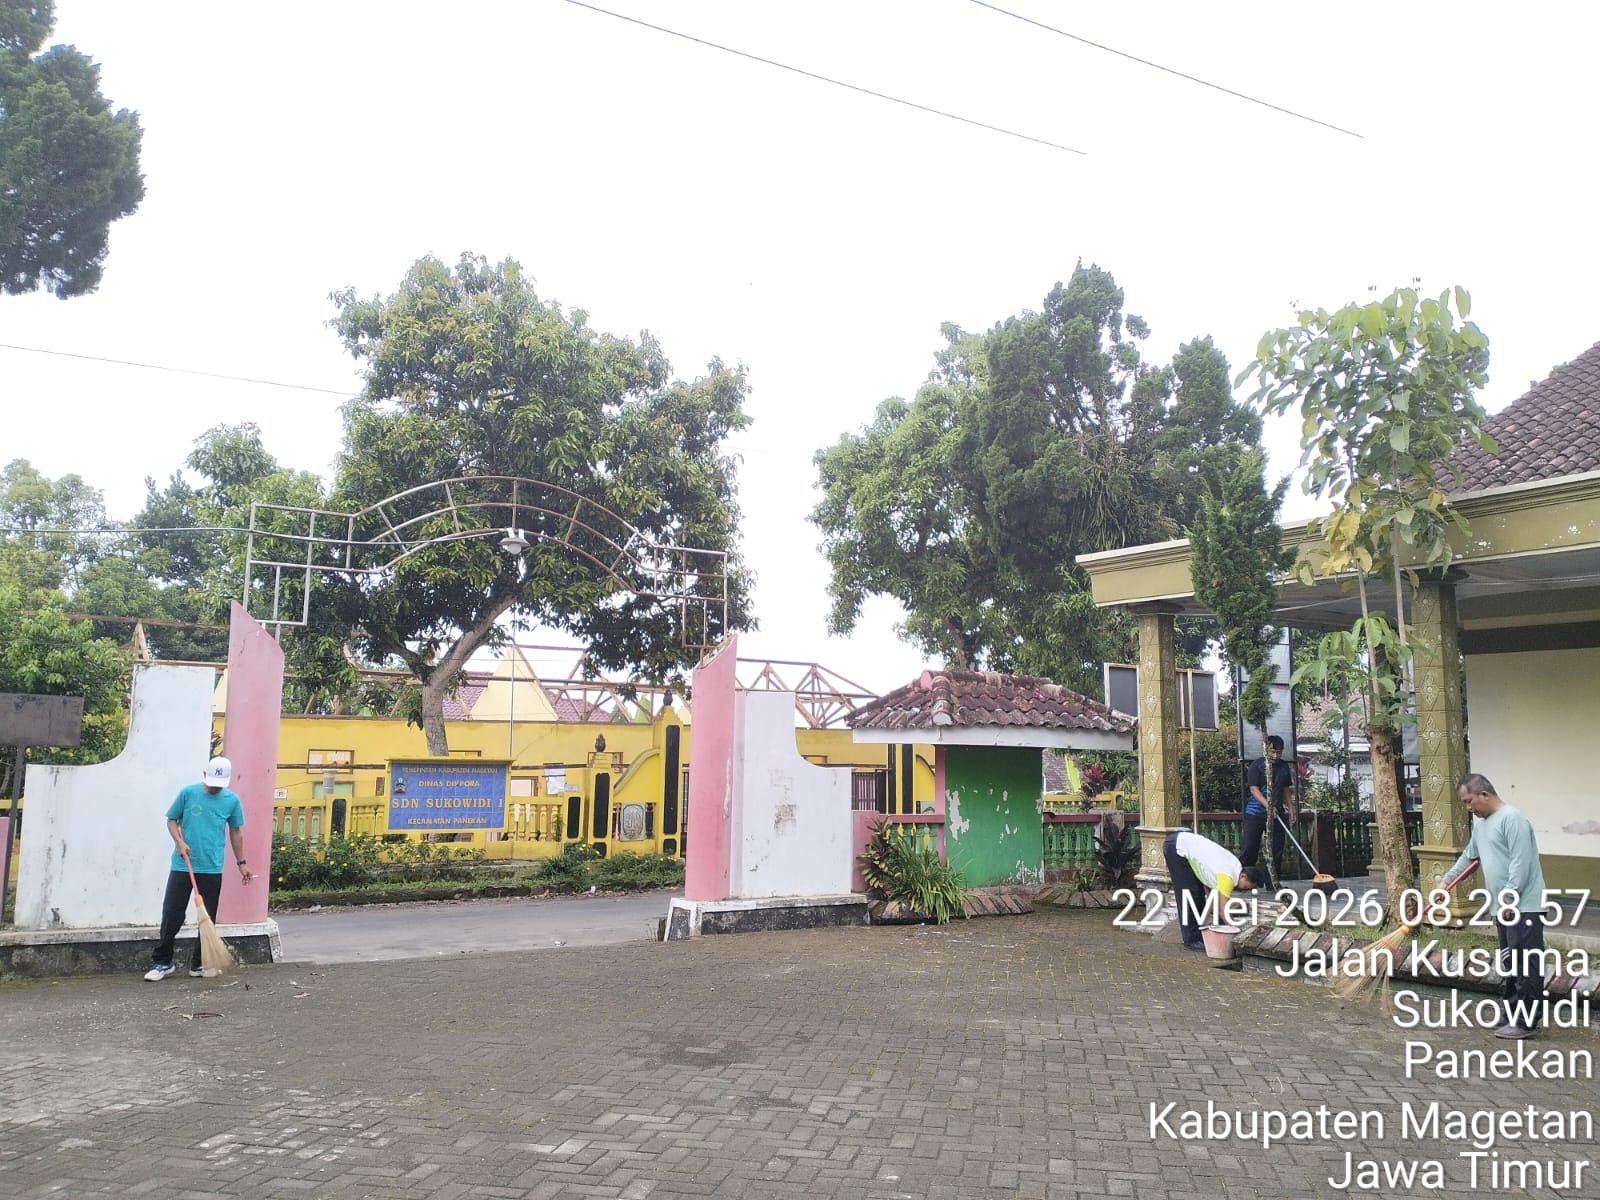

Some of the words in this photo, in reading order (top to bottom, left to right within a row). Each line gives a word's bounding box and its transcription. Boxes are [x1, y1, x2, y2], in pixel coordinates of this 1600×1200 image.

[391, 798, 419, 809] SDN
[426, 798, 491, 808] SUKOWIDI
[407, 817, 451, 825] KECAMATAN
